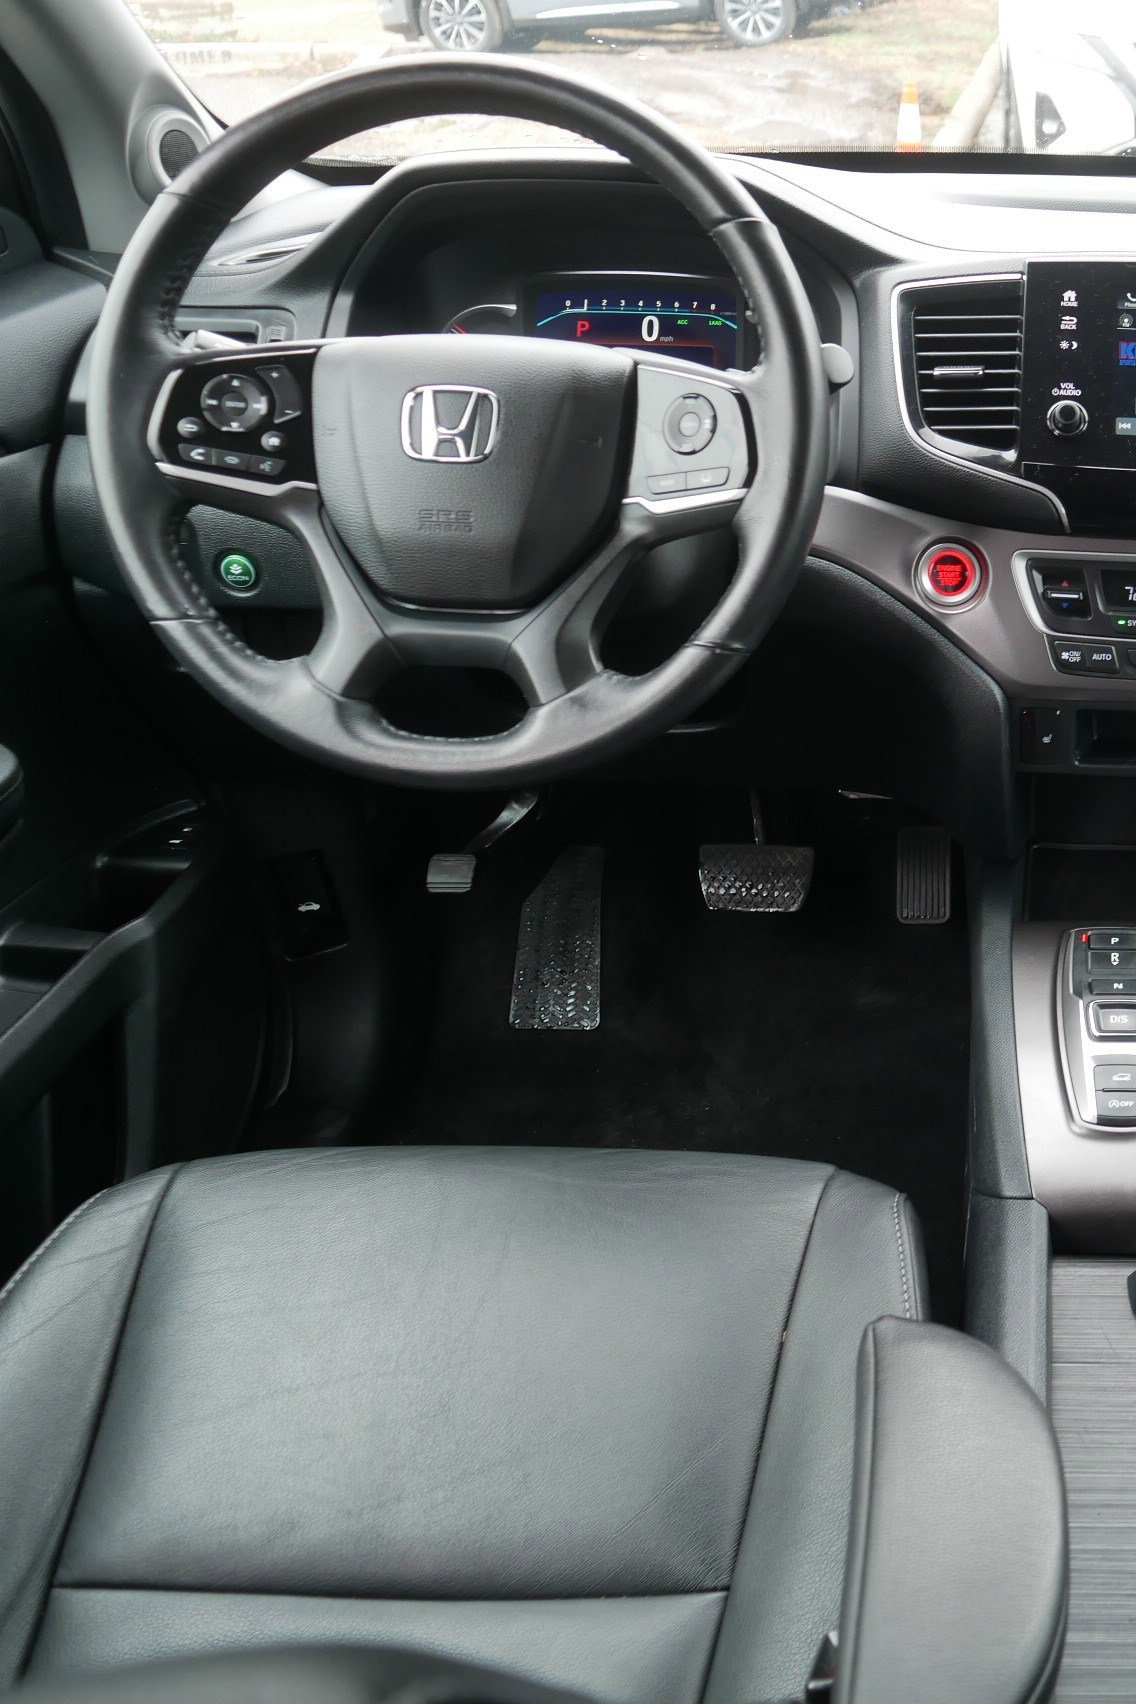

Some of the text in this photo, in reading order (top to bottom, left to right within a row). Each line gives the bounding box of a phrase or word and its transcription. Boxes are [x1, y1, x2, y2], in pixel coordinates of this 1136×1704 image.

[576, 321, 590, 337] P
[642, 316, 659, 342] 0
[1111, 937, 1119, 945] P
[1111, 953, 1119, 962] R
[1110, 1016, 1128, 1024] D/S
